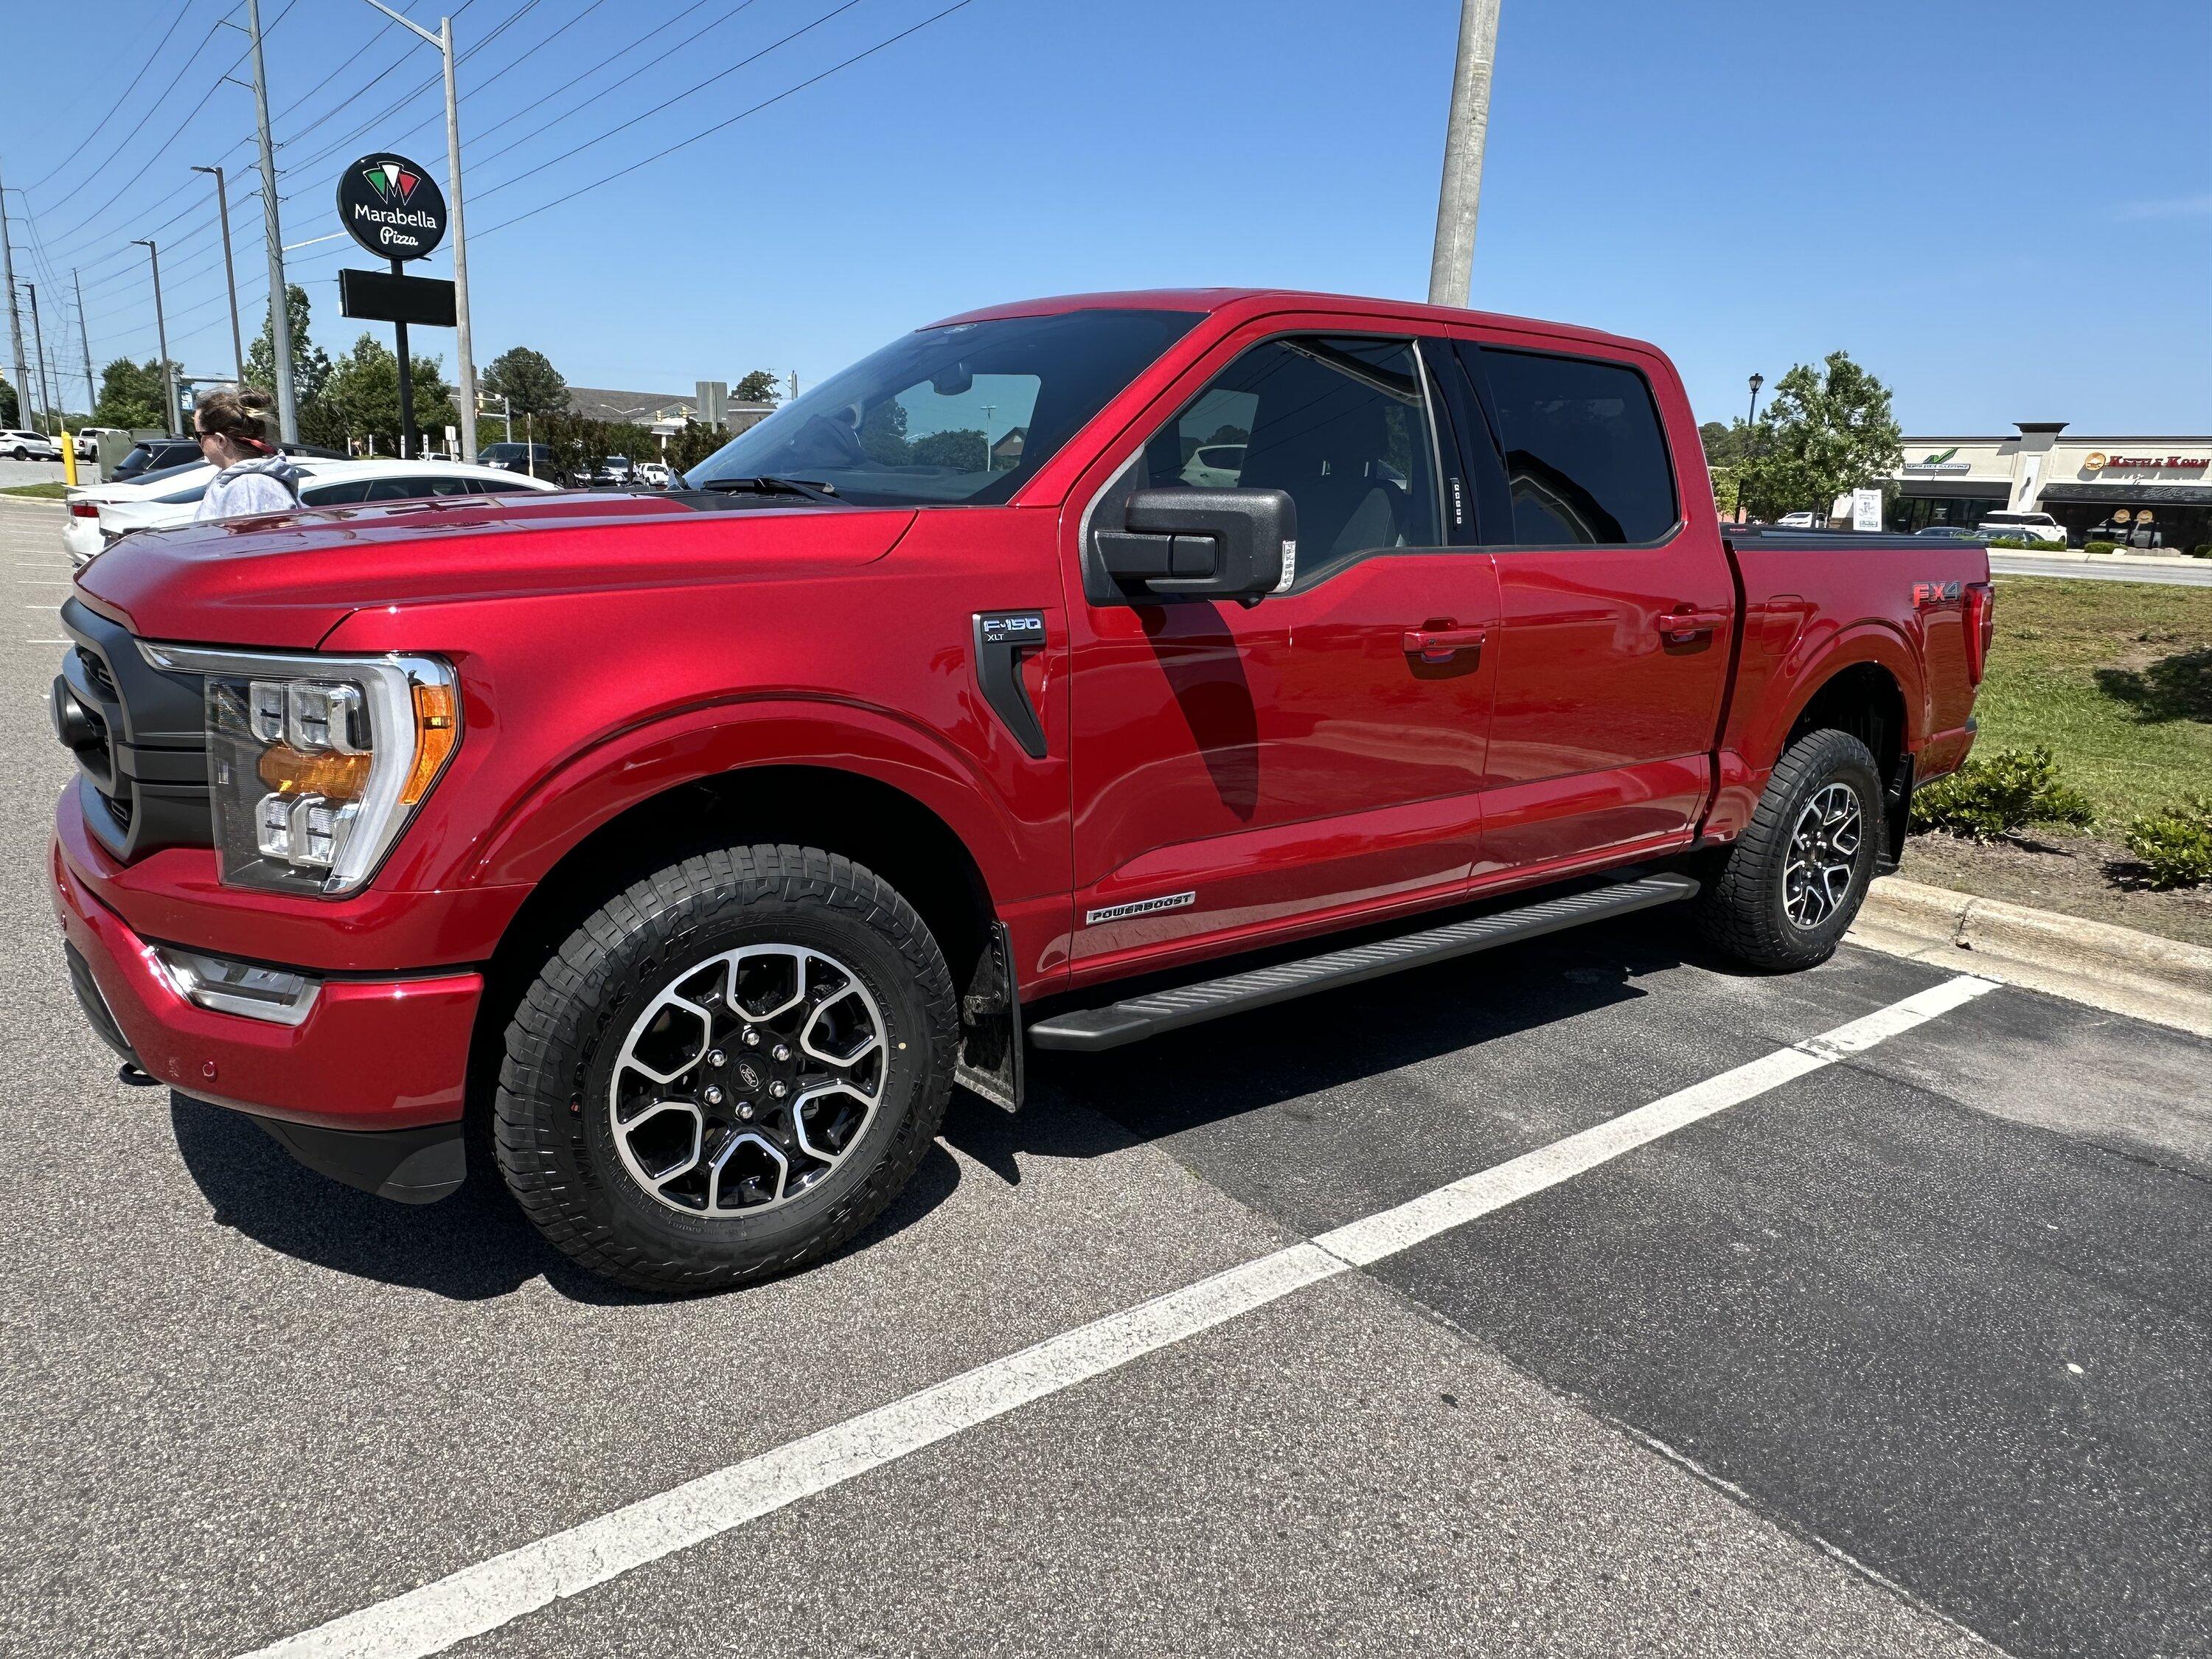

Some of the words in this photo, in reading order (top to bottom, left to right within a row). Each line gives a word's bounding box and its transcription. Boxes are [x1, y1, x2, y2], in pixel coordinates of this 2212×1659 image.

[355, 204, 437, 229] Marabella
[380, 226, 419, 246] Pizza
[1913, 581, 1961, 609] FX4
[984, 618, 1041, 632] F-150
[987, 633, 1004, 641] XLT
[1092, 894, 1191, 921] POWERBOOST
